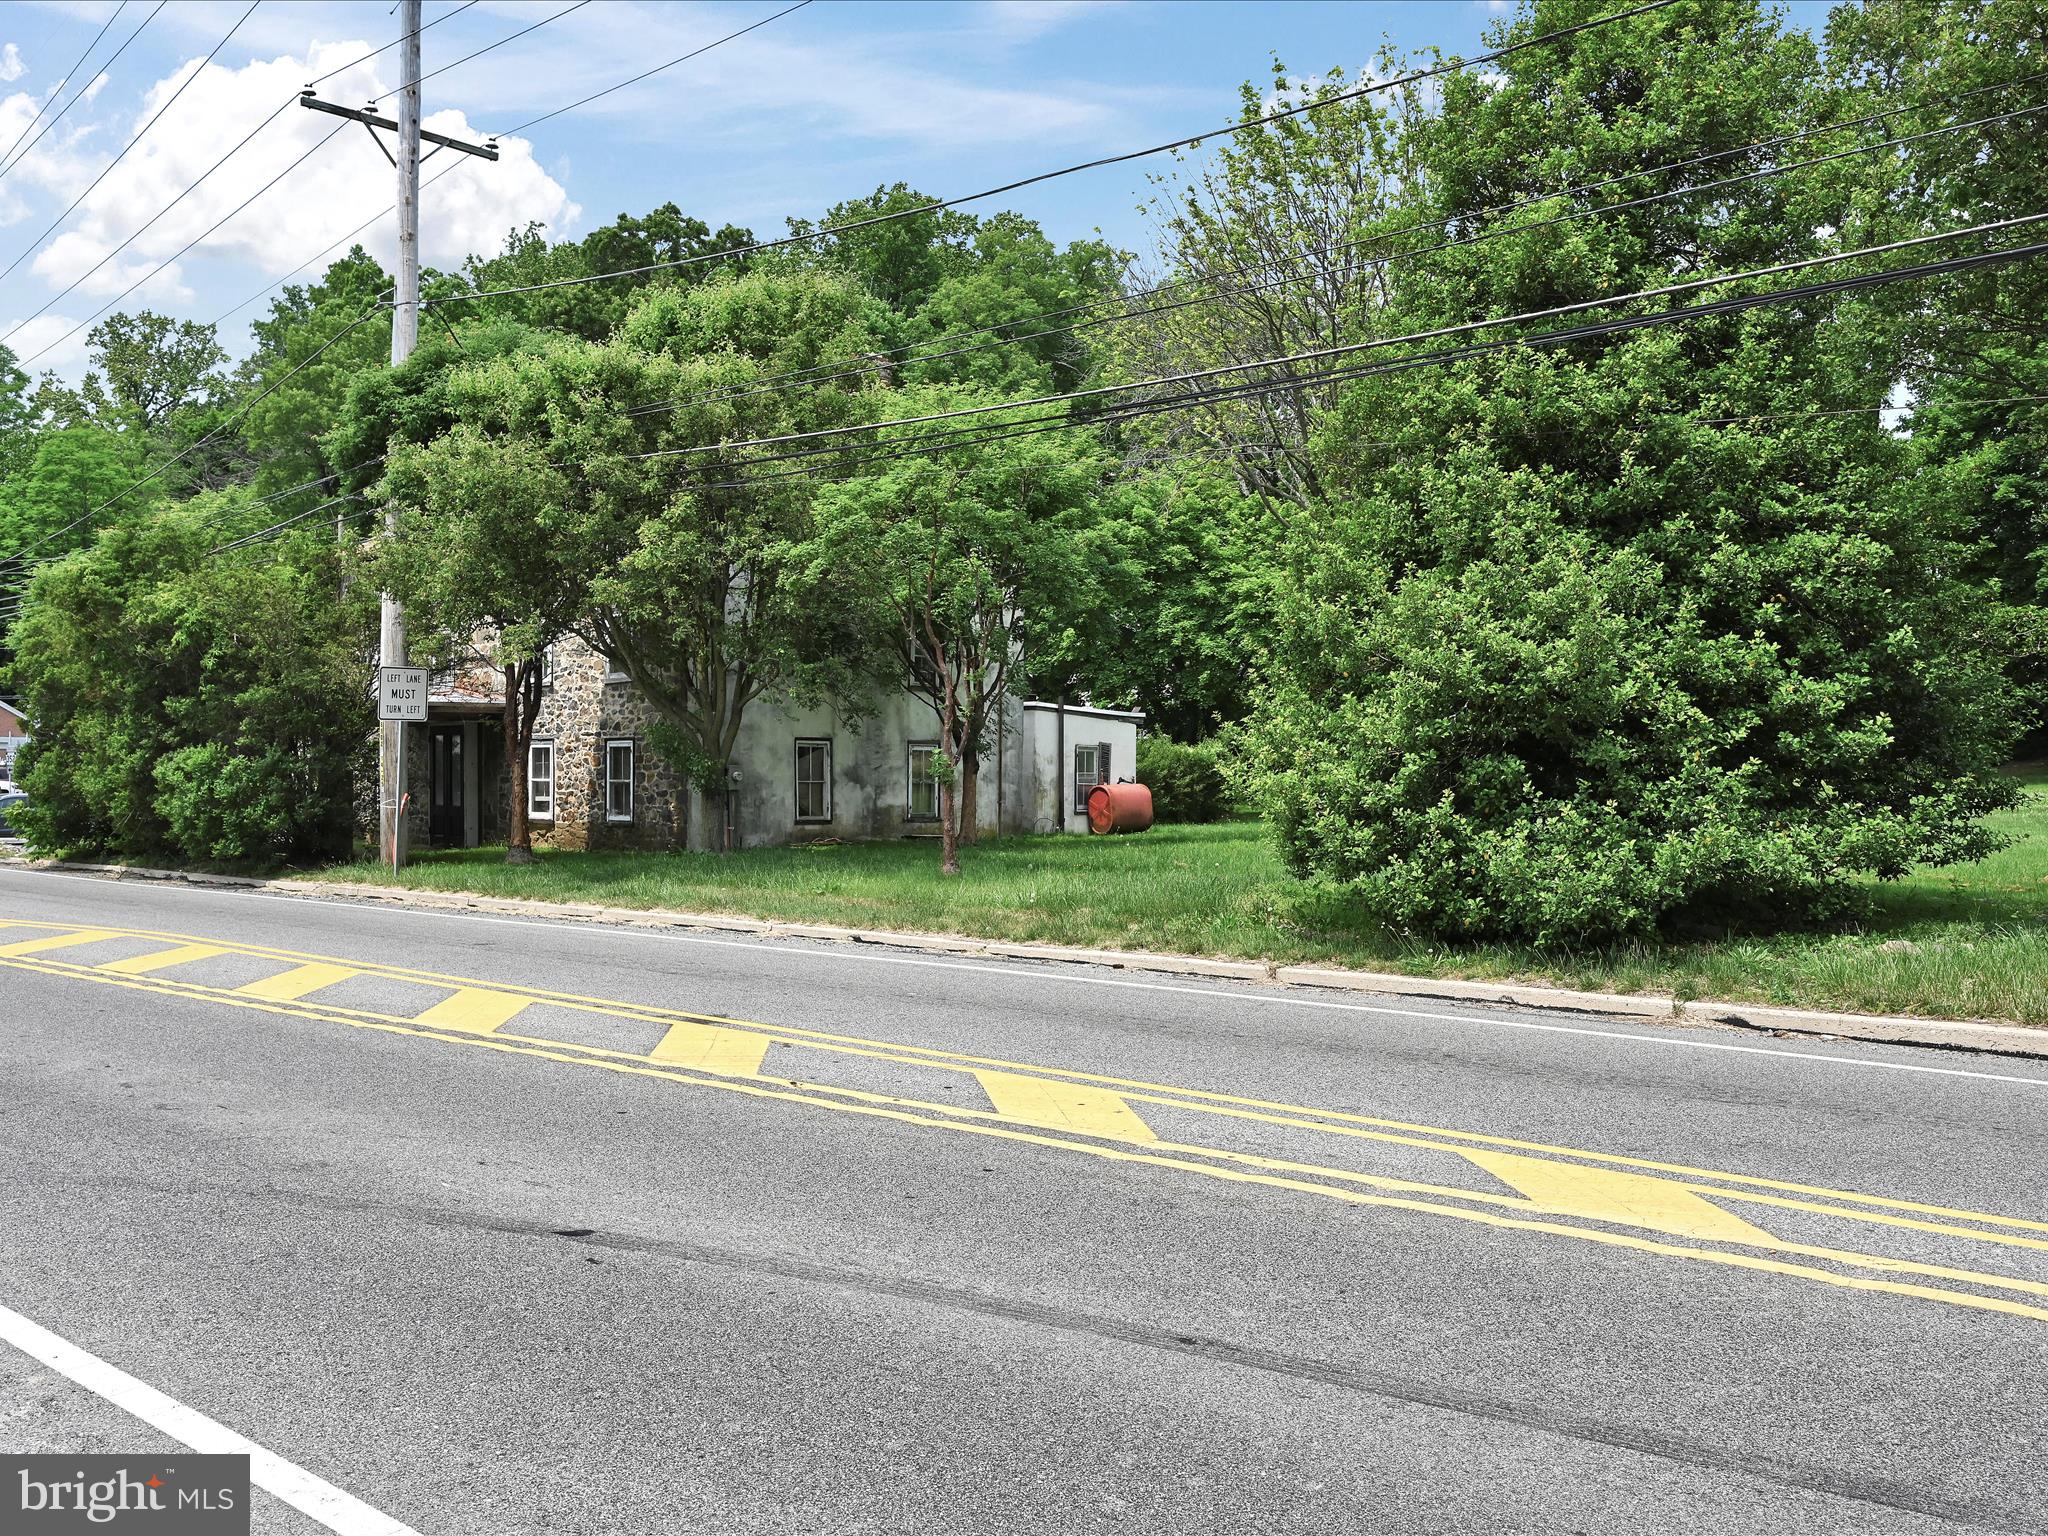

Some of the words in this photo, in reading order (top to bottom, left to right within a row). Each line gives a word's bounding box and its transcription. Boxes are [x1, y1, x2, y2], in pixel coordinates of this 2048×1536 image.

[387, 674, 400, 682] LEFT
[406, 675, 421, 683] LANE
[391, 689, 416, 699] MUST
[386, 705, 401, 713] TURN
[406, 706, 420, 714] LEFT
